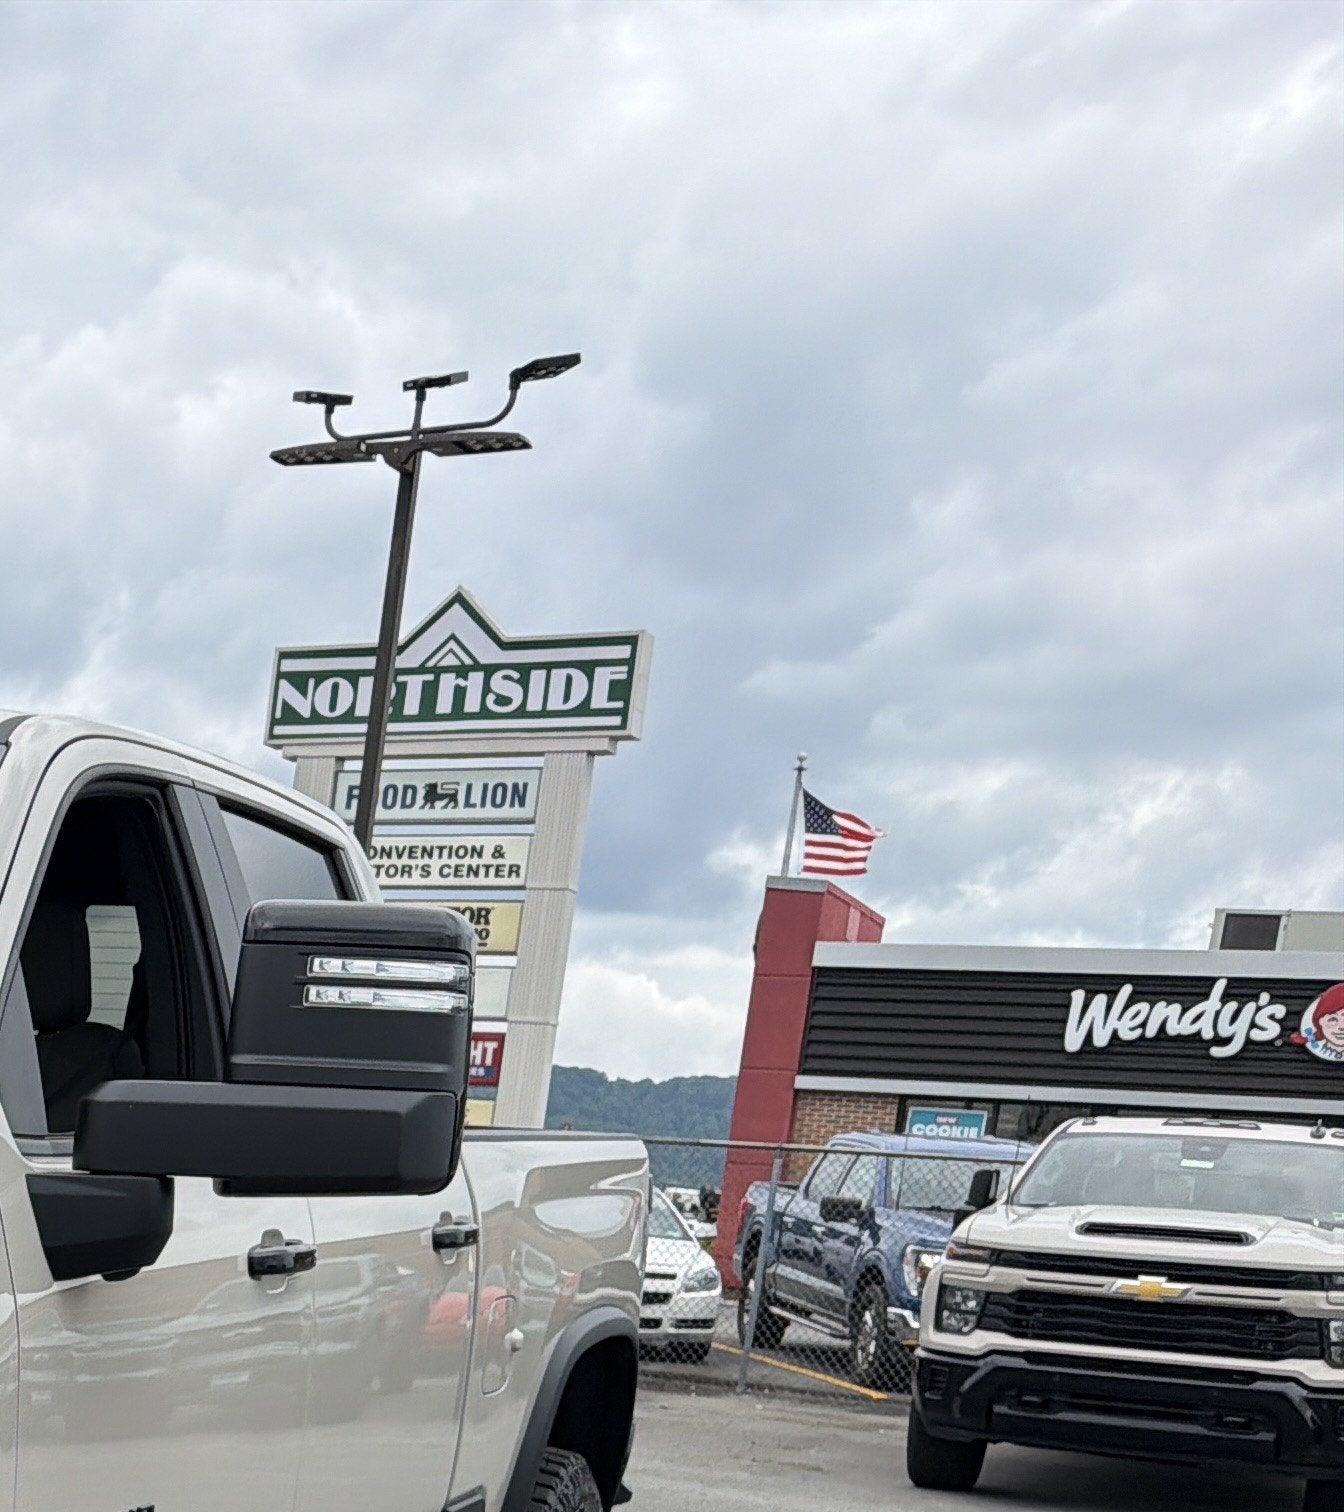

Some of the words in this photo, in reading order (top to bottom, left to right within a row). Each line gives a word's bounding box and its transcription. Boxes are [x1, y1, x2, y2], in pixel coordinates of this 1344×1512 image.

[345, 783, 417, 810] FOD
[463, 781, 529, 809] LION
[367, 844, 484, 860] ONVENTION
[491, 844, 506, 860] &
[372, 864, 431, 879] TOR'S
[439, 864, 521, 879] CENTER
[1064, 978, 1287, 1057] Wendy's
